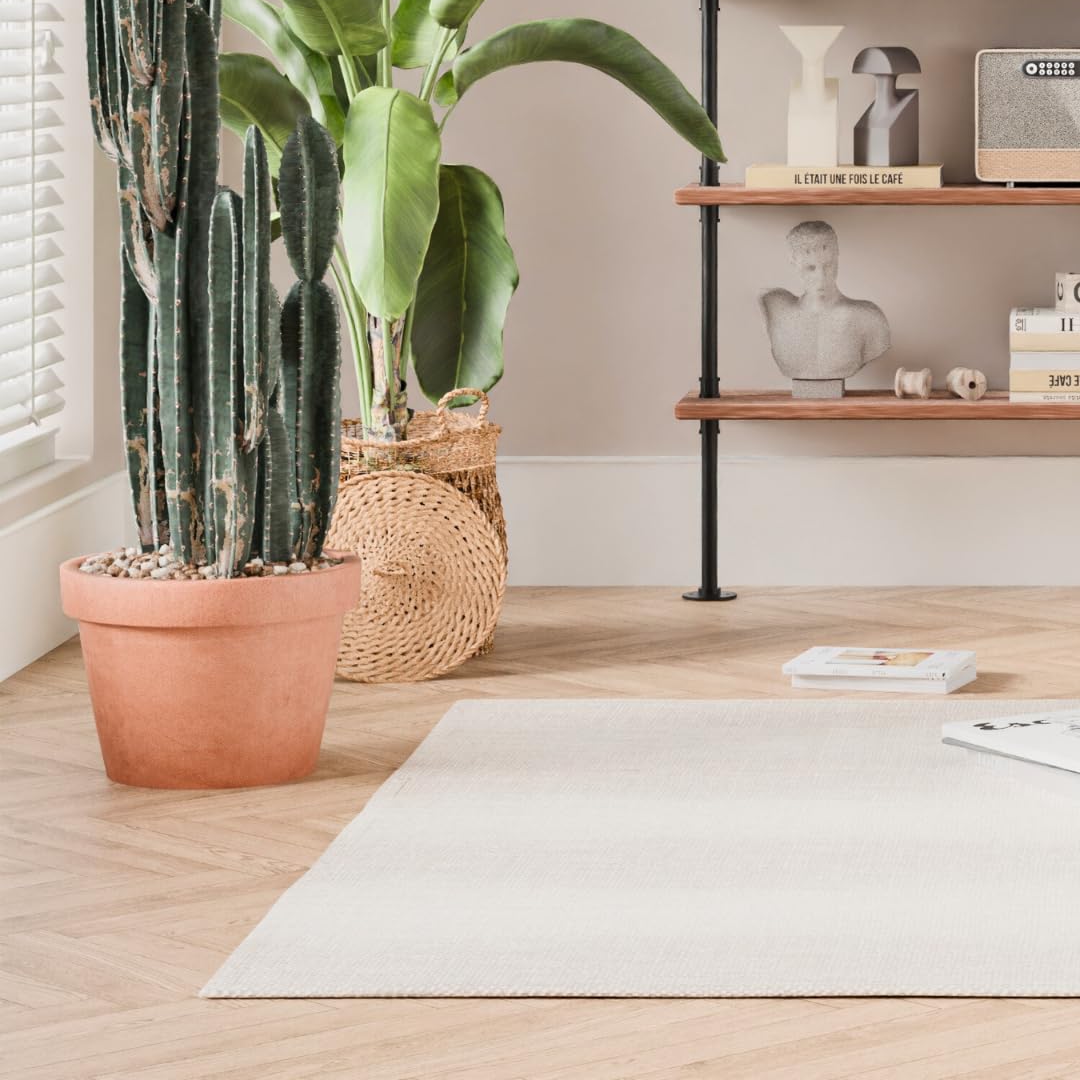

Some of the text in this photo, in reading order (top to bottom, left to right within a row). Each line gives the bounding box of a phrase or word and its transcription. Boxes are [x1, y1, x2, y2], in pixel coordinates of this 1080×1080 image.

[795, 173, 903, 184] IL ÉTAIT UNE FOIS LE CAFÉ
[1049, 375, 1072, 389] CAFÉ
